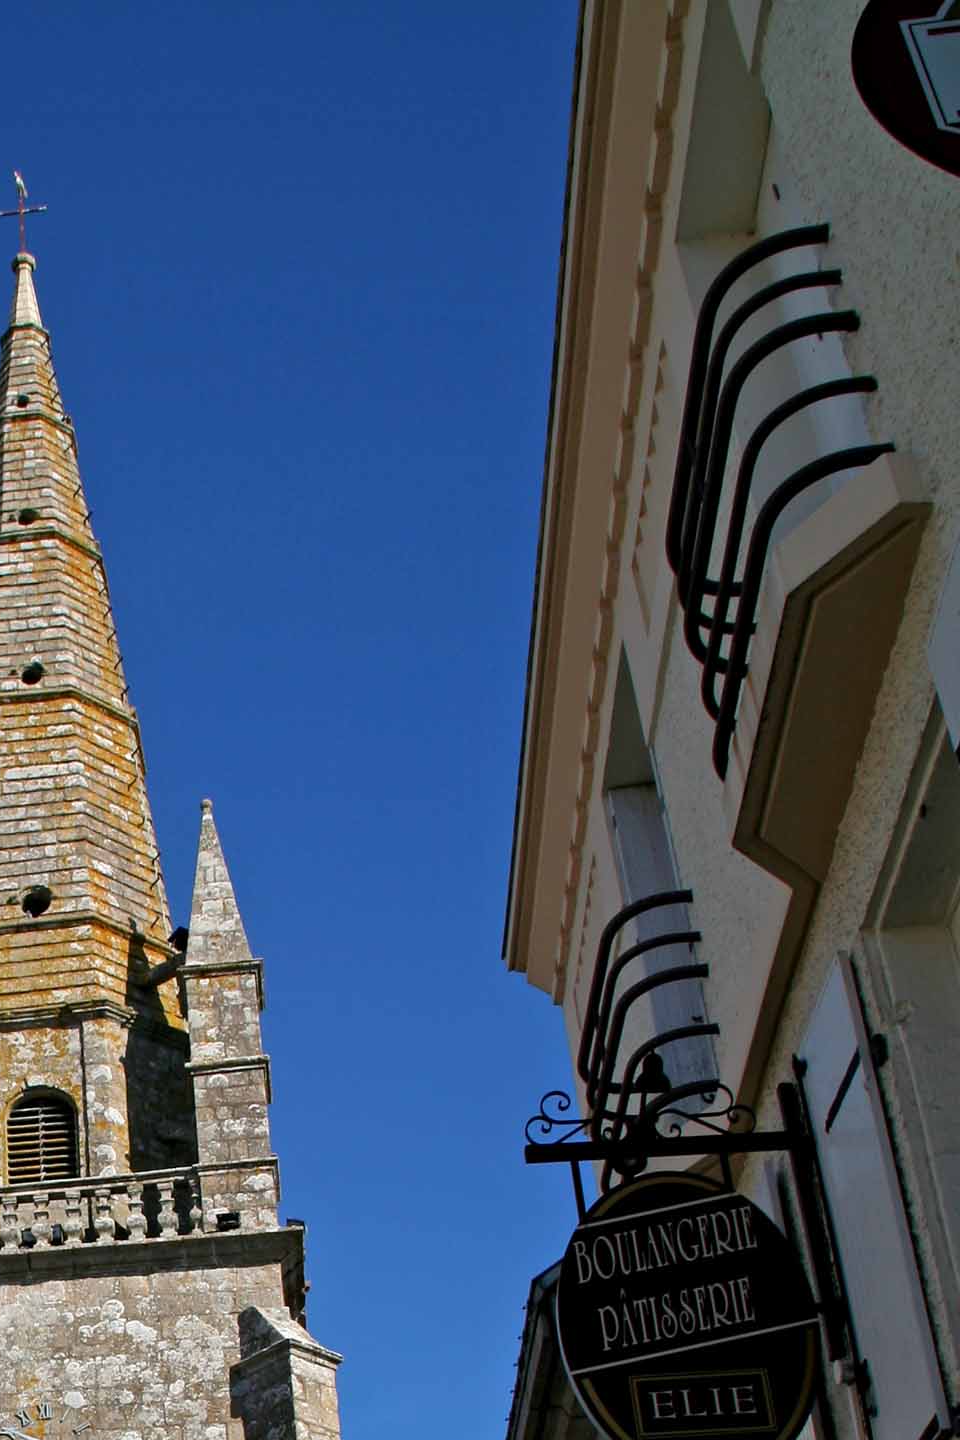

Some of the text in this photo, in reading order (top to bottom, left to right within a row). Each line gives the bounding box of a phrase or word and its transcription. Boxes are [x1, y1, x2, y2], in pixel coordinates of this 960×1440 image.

[573, 1206, 758, 1284] BOULANGERIE
[597, 1276, 756, 1351] PÂTISSERIE
[648, 1385, 757, 1419] ELIE
